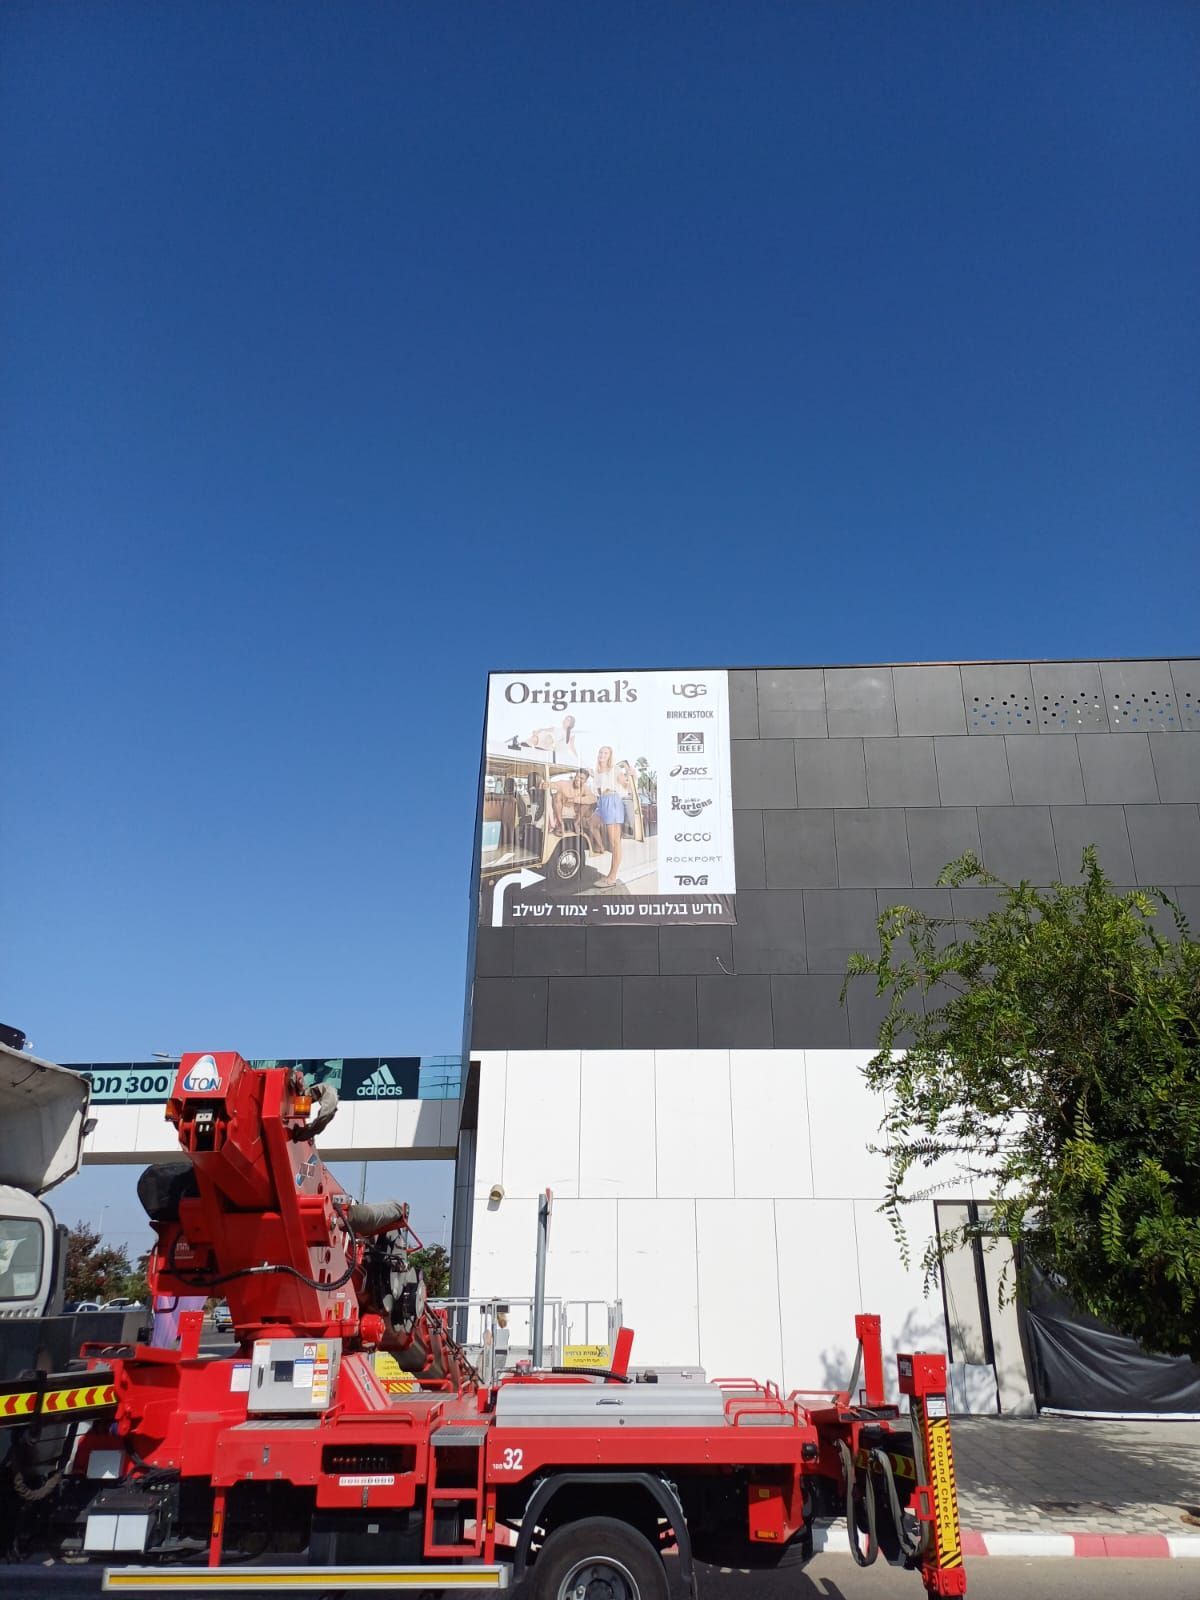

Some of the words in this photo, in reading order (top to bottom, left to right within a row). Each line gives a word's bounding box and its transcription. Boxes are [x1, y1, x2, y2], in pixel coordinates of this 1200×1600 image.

[505, 680, 637, 711] Original's
[672, 683, 707, 698] UGG
[666, 710, 714, 719] BIRKENSTOCK
[679, 744, 703, 752] REEF
[674, 832, 711, 842] ecco
[512, 903, 553, 917] לשילב
[556, 904, 588, 916] צמוד
[602, 904, 635, 916] סנטר
[639, 902, 688, 916] בגלובוס
[692, 903, 723, 915] חדש
[91, 1077, 122, 1094] מט
[124, 1076, 169, 1093] 300
[356, 1084, 403, 1096] adidas
[503, 1448, 523, 1470] 32
[936, 1435, 947, 1483] Ground
[941, 1489, 951, 1529] Check
